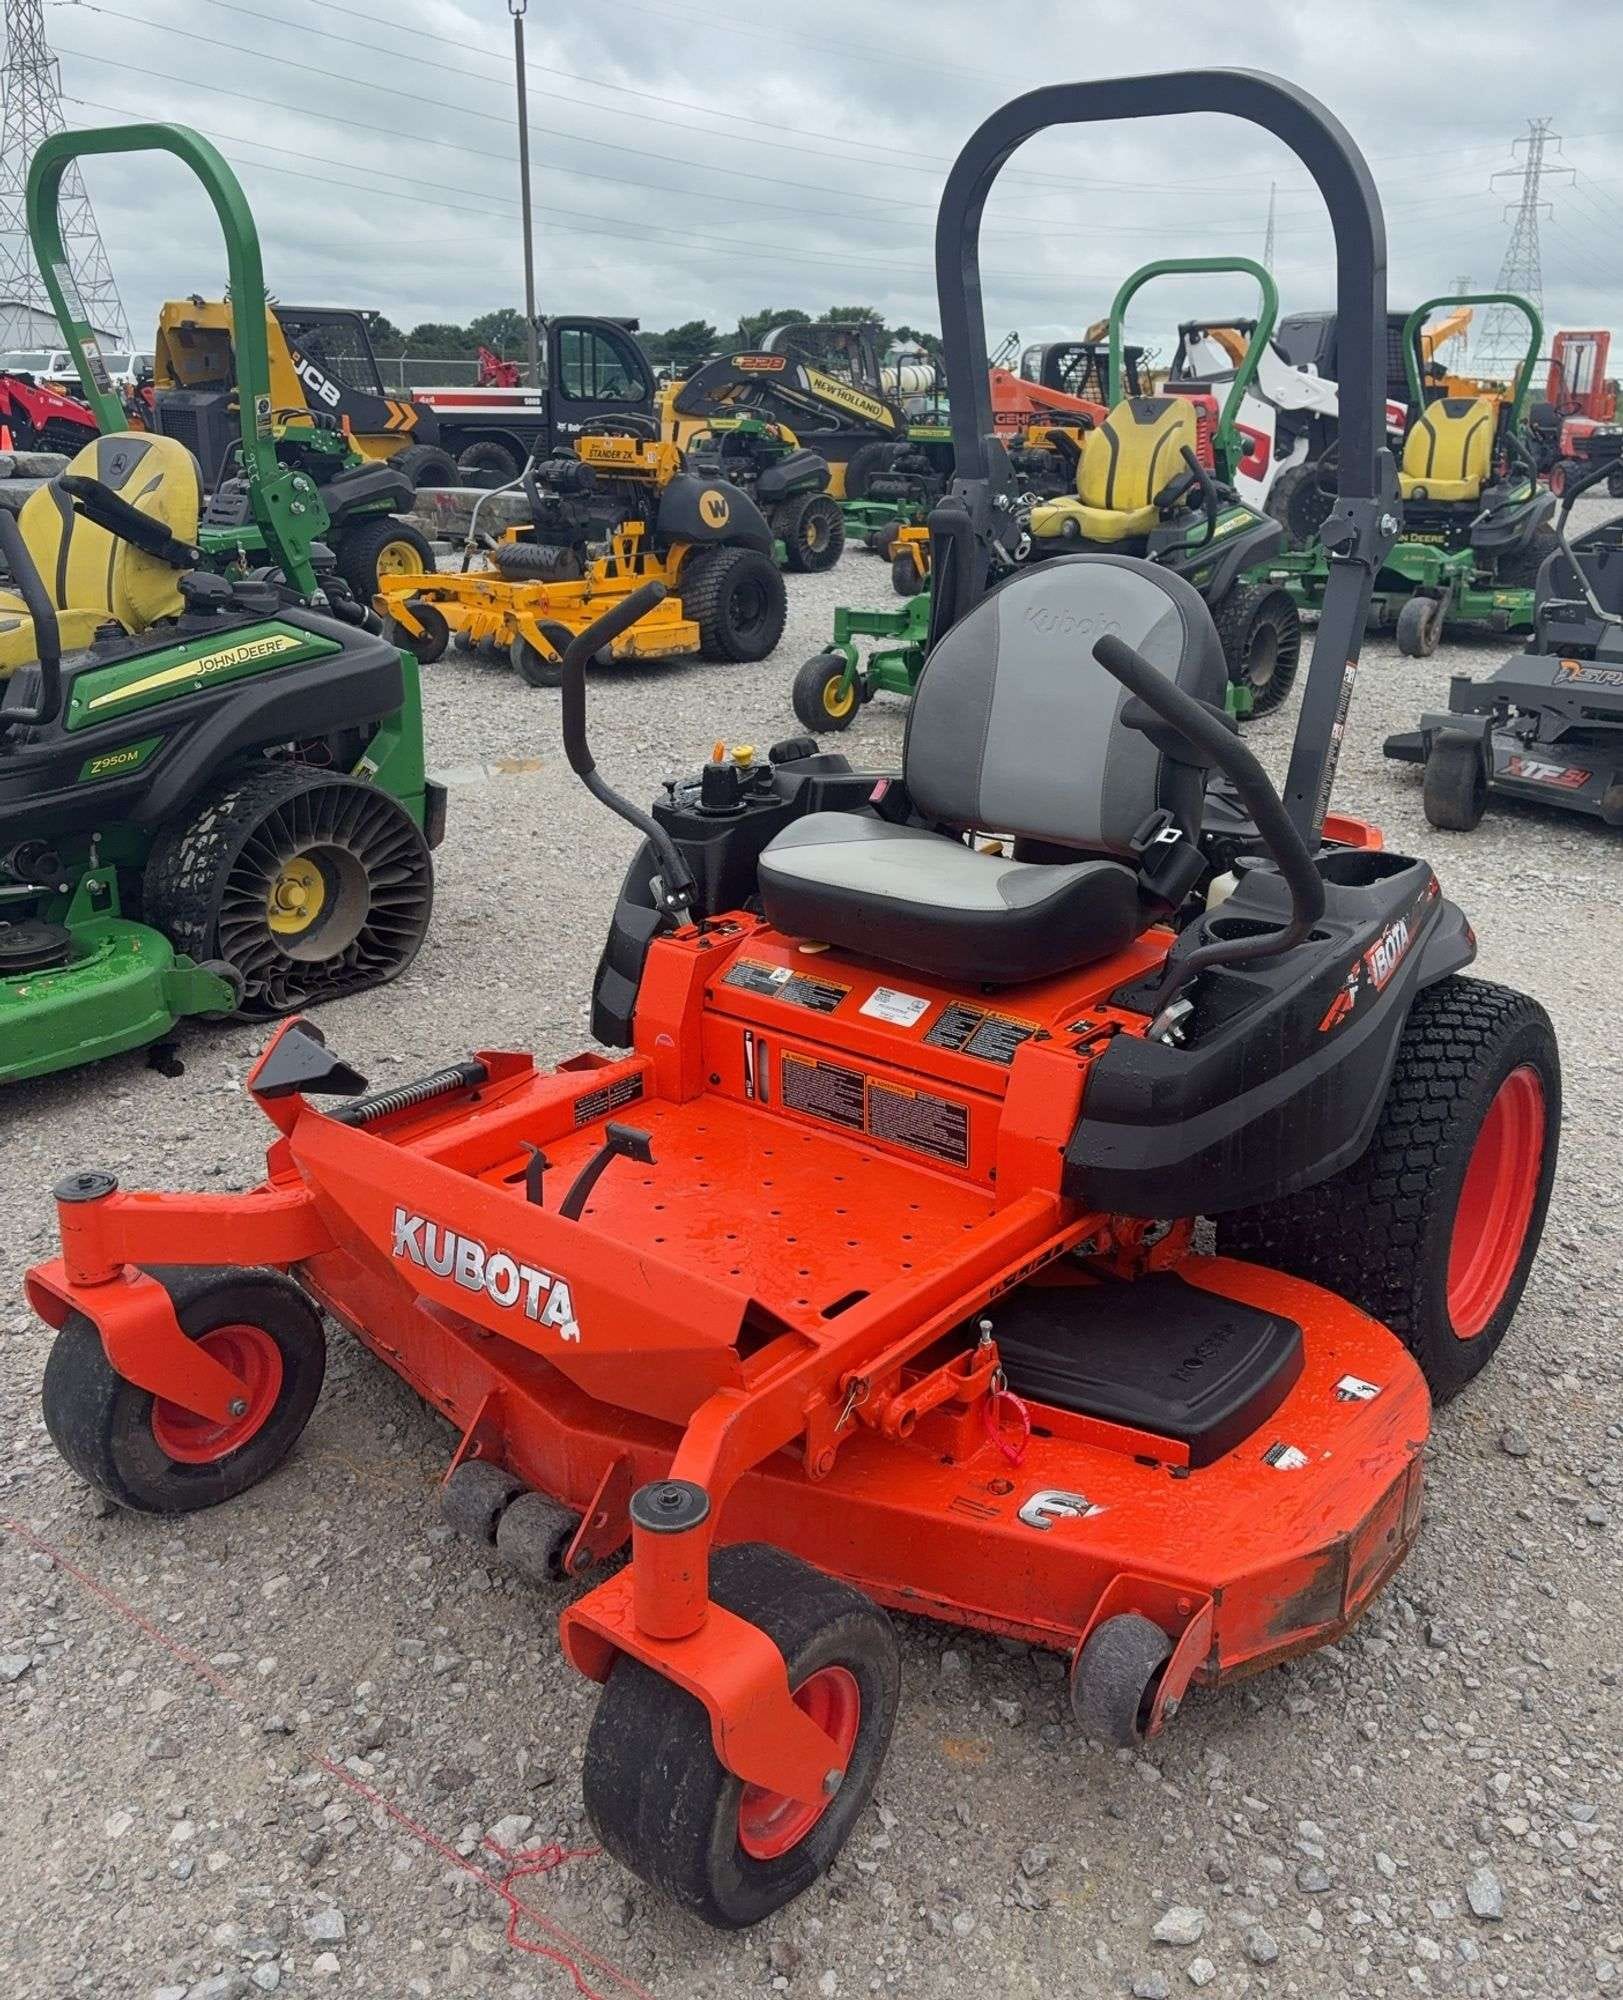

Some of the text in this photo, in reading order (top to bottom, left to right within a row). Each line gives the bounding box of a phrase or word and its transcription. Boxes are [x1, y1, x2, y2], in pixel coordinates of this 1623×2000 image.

[292, 359, 340, 407] JCB
[813, 378, 880, 417] NEW HOLLAND
[589, 449, 620, 458] STANDER
[708, 500, 726, 518] W
[198, 639, 284, 675] JOHN DEERE
[91, 750, 139, 774] Z950M
[393, 1207, 579, 1336] KUBOTA
